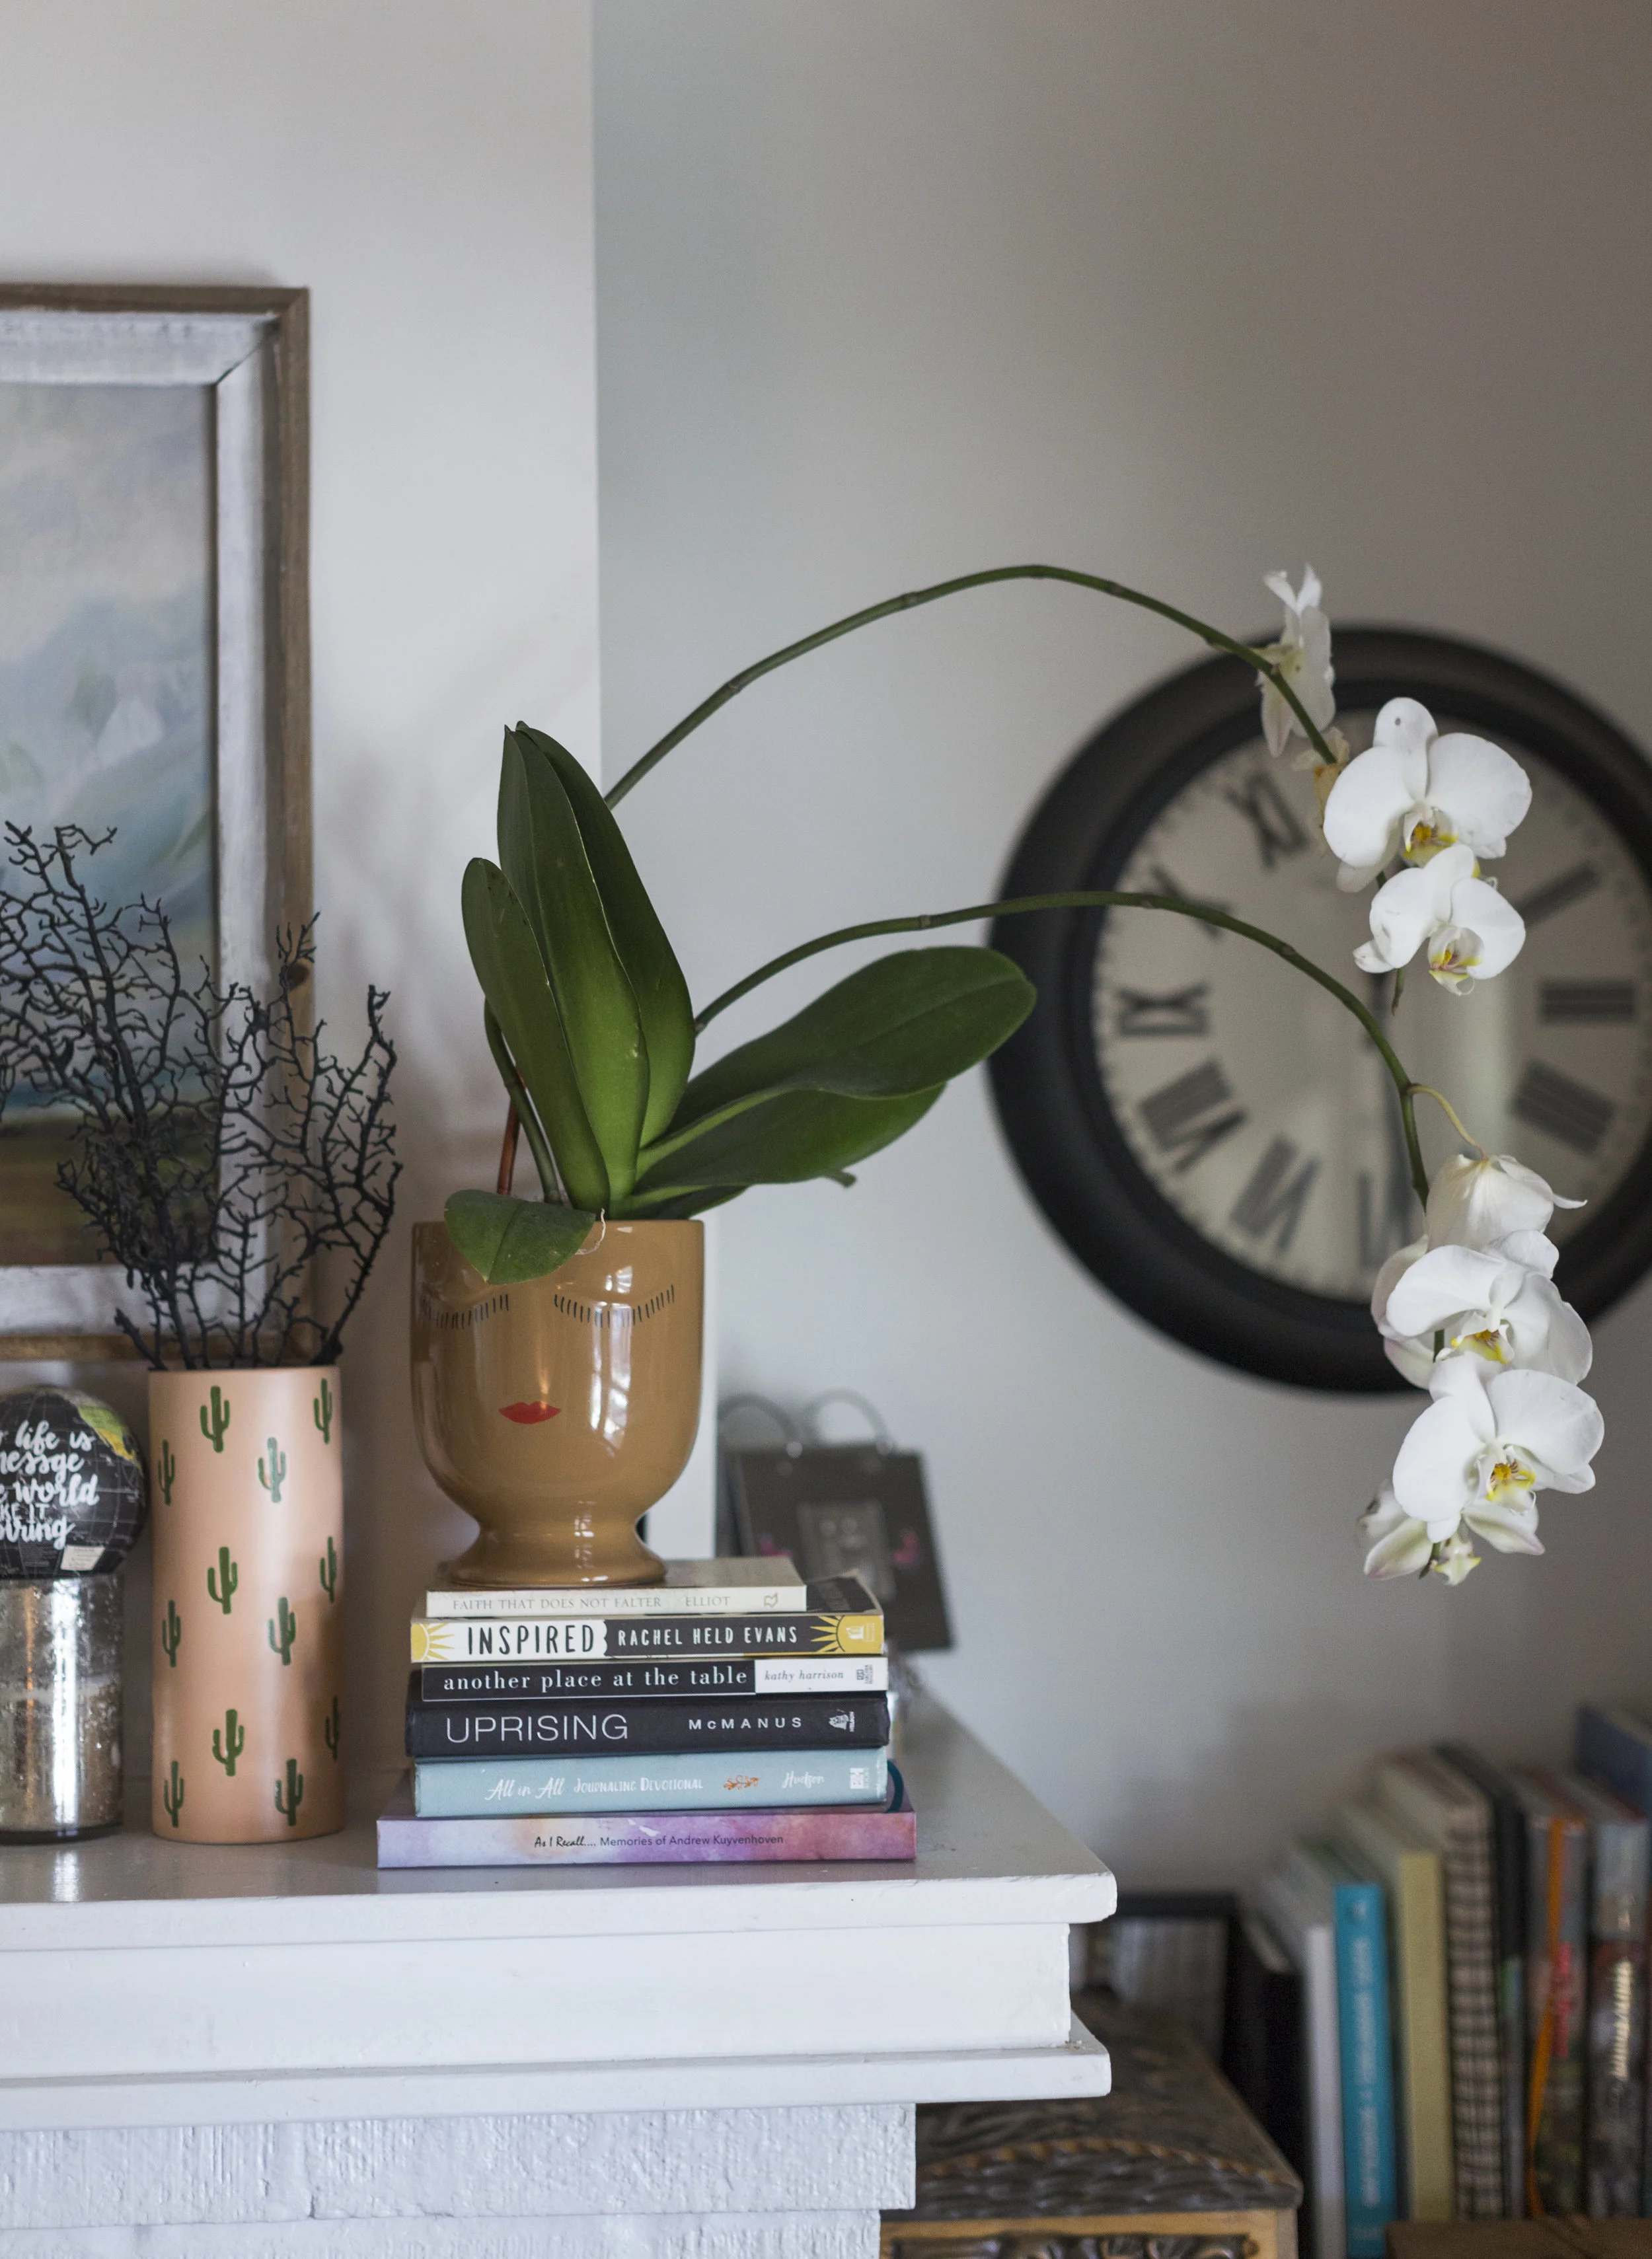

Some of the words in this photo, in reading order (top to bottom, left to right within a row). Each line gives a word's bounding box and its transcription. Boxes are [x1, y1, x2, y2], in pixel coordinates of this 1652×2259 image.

[15, 1420, 61, 1456] life
[69, 1430, 96, 1452] is
[12, 1472, 100, 1507] world
[453, 1600, 492, 1610] FAITH
[498, 1599, 535, 1610] THAT
[541, 1598, 574, 1609] DOES
[580, 1598, 609, 1608] NOT
[615, 1597, 661, 1608] FALTER
[685, 1596, 732, 1607] ELLIOT
[468, 1625, 594, 1655] INSPIRED
[618, 1628, 683, 1647] RACHEL
[693, 1627, 734, 1645] HELD
[744, 1626, 798, 1644] EVANS
[443, 1670, 531, 1690] another
[541, 1669, 602, 1693] place
[613, 1671, 633, 1686] at
[644, 1667, 679, 1685] the
[691, 1666, 747, 1685] table
[765, 1670, 795, 1683] kathy
[798, 1668, 845, 1680] harrison
[446, 1714, 628, 1744] UPRISING
[689, 1718, 802, 1730] McMANUS
[485, 1778, 515, 1800] All
[517, 1785, 531, 1796] in
[535, 1777, 566, 1799] All
[534, 1836, 546, 1847] As
[600, 1837, 652, 1847] Memories
[656, 1836, 666, 1845] of
[669, 1835, 710, 1845] Andrew
[714, 1835, 784, 1847] Kuyvenhoven
